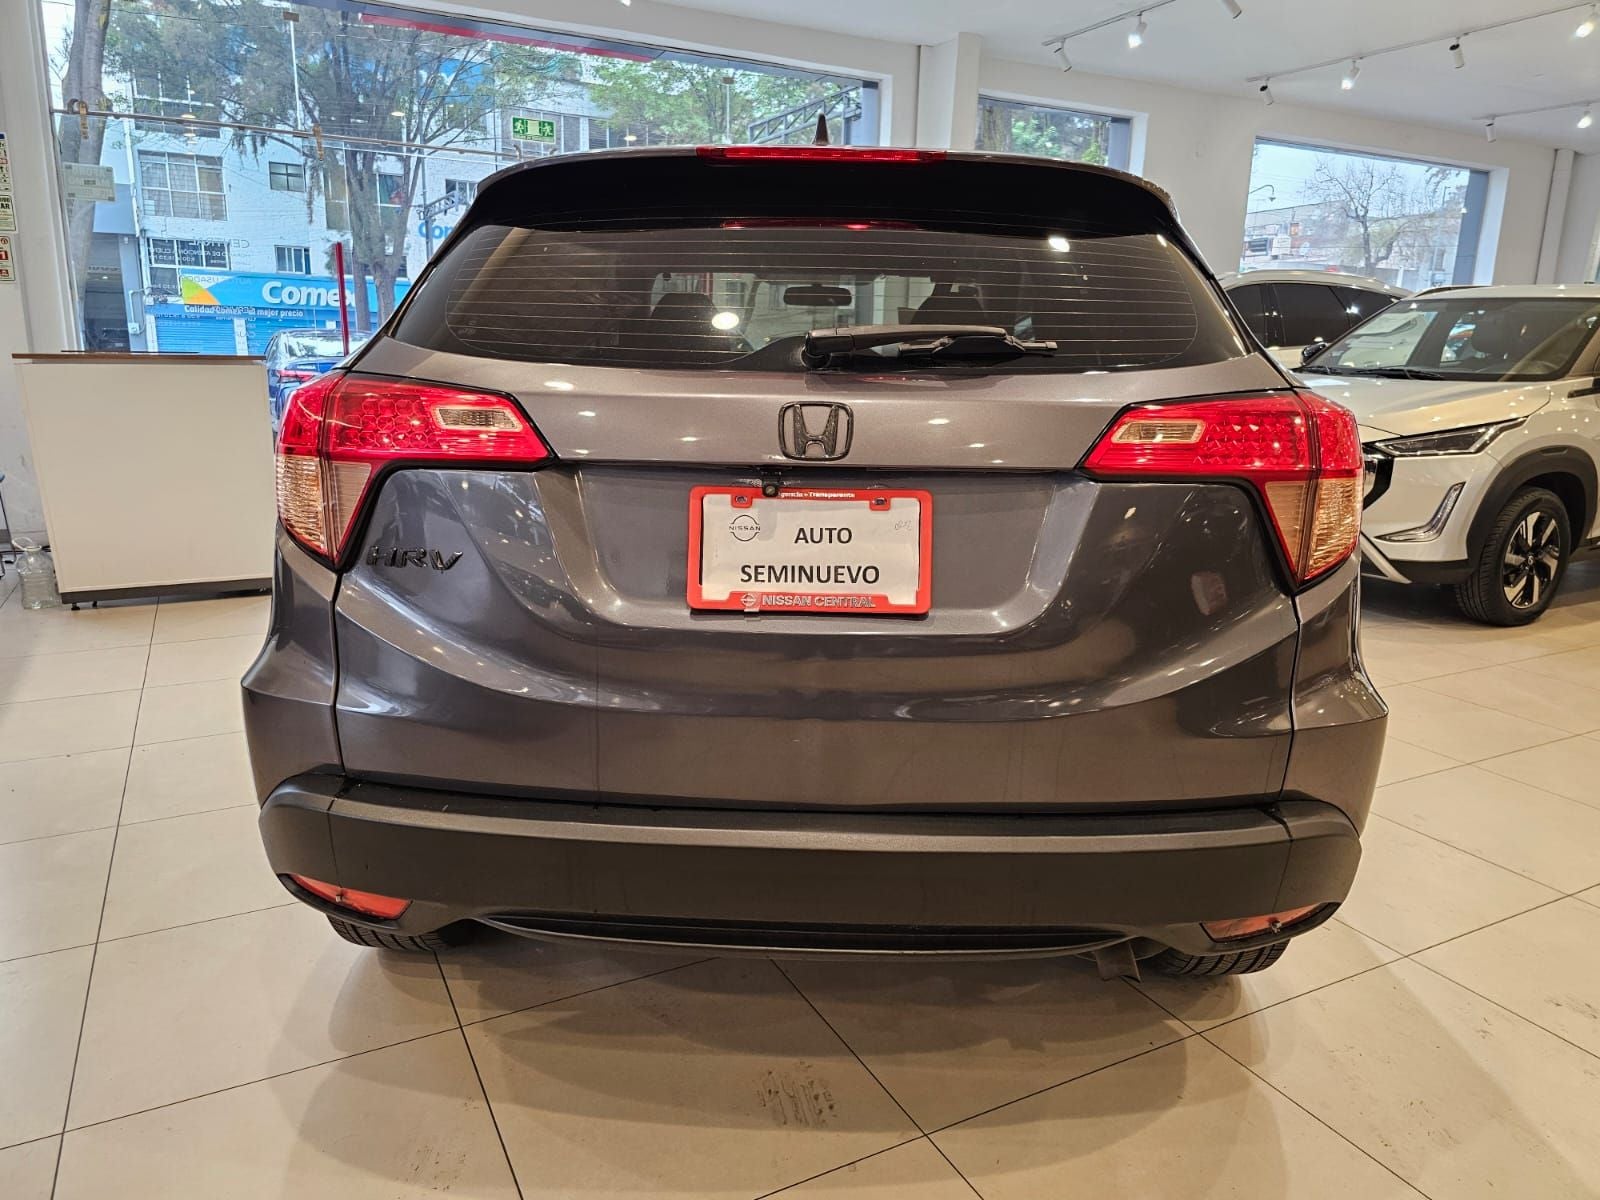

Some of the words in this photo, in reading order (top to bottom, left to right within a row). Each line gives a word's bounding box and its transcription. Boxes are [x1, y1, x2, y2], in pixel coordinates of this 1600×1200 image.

[184, 304, 215, 314] Calidad
[257, 308, 279, 318] mejor
[280, 309, 304, 319] precio
[794, 527, 853, 544] AUTO
[740, 564, 880, 585] SEMINUEVO
[762, 594, 812, 607] NISSAN
[814, 595, 876, 608] CENTRAL
